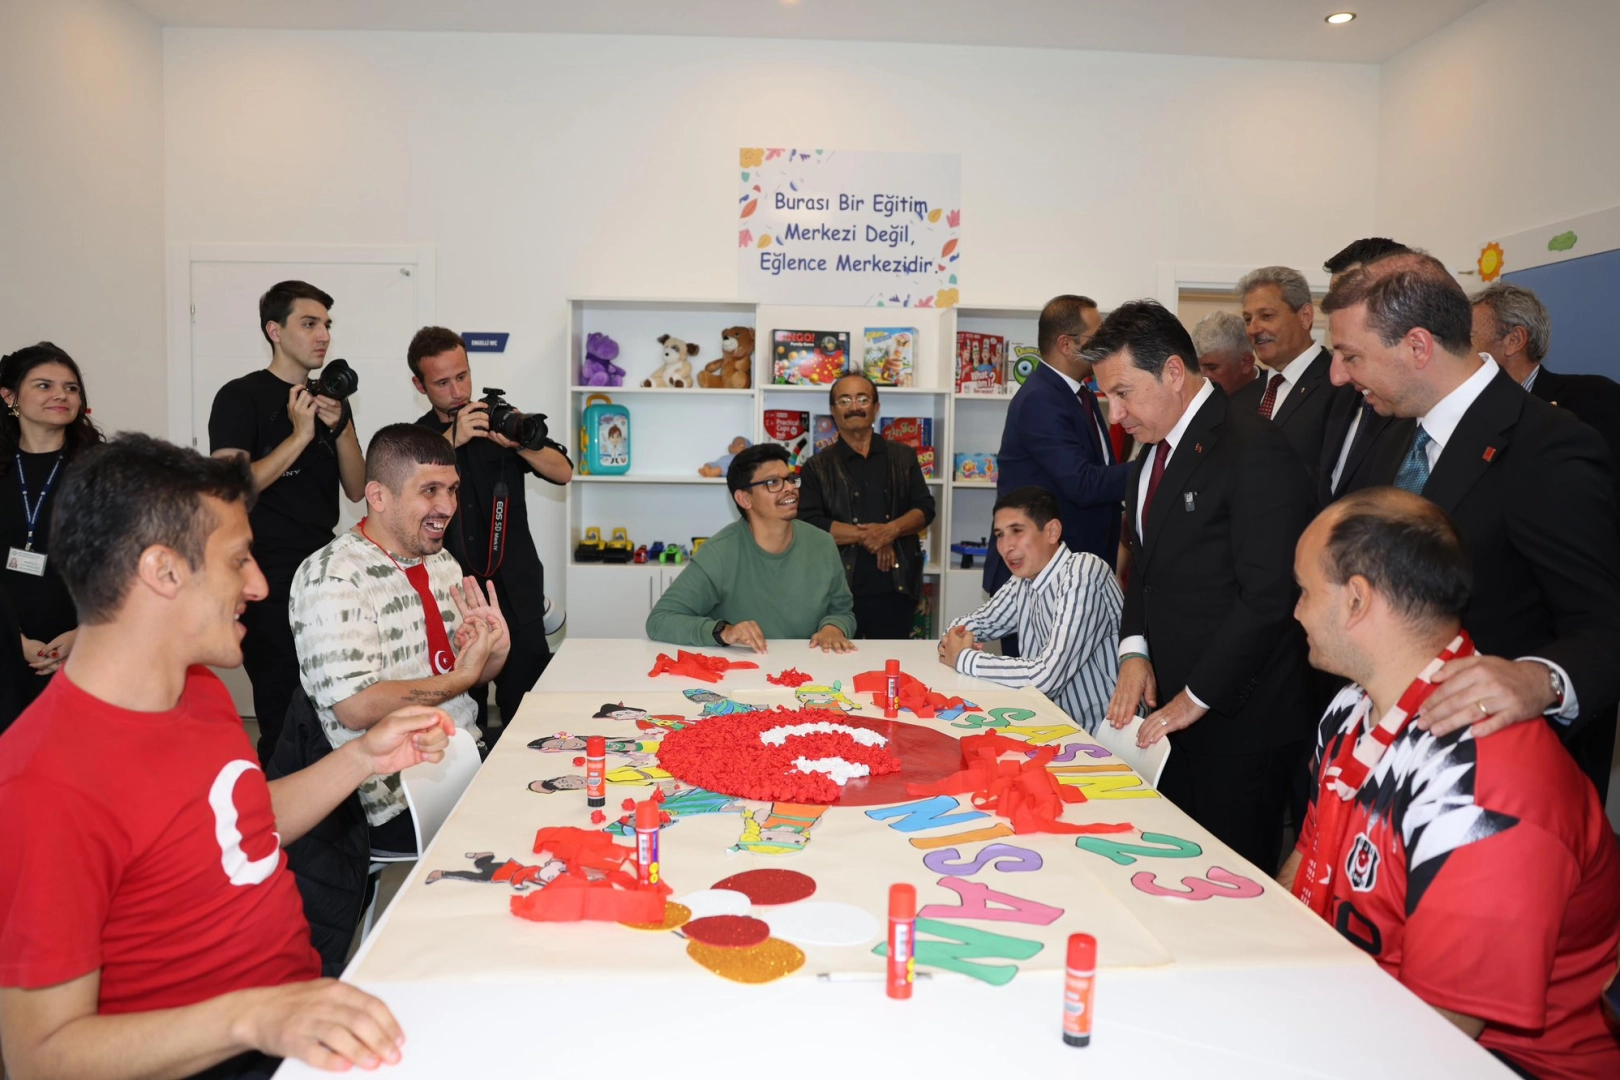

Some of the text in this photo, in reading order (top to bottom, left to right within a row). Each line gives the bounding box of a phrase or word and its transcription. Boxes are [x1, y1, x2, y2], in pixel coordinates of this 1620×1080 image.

[775, 192, 928, 218] Burası Bir Eğitim
[785, 223, 915, 248] Merkezi Değil,
[760, 252, 938, 275] Eğlence Merkezidir.
[917, 451, 935, 466] NO
[495, 501, 504, 521] EOS
[494, 521, 502, 532] 5D
[1075, 831, 1265, 901] 23
